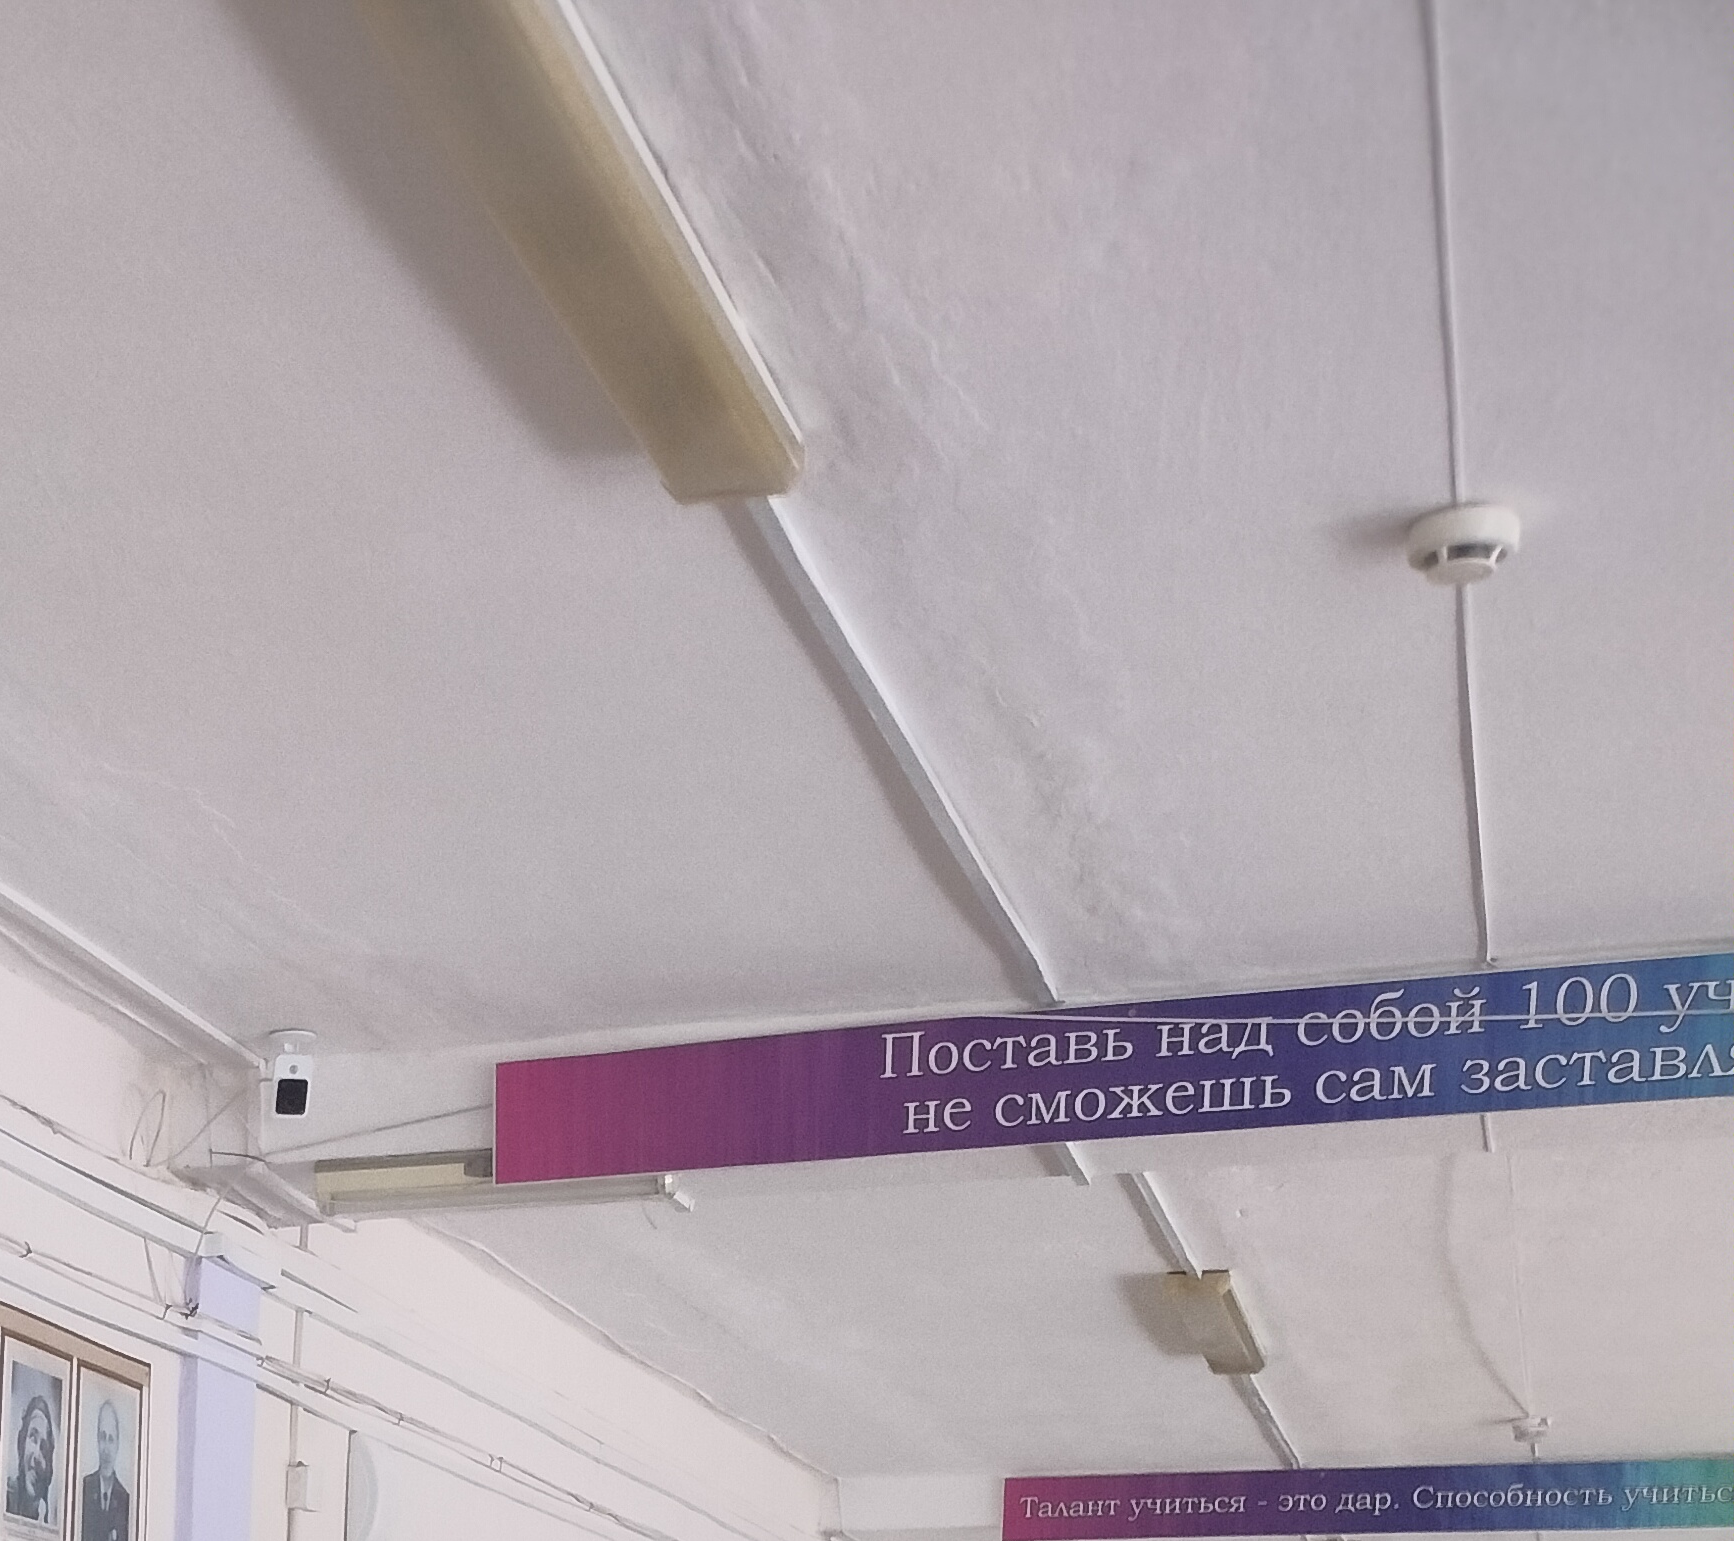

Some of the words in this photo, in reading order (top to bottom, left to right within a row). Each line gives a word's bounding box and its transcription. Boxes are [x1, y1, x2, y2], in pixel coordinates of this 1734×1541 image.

[879, 1027, 1134, 1079] Поставь
[1155, 1016, 1275, 1060] над
[1296, 985, 1488, 1047] собой
[1519, 972, 1639, 1030] 100
[902, 1095, 973, 1135] не
[994, 1073, 1292, 1128] сможешь
[1315, 1062, 1437, 1104] сам
[1460, 1041, 1734, 1095] заставл
[1019, 1496, 1121, 1520] Талант
[1127, 1495, 1247, 1522] учиться
[1276, 1492, 1327, 1514] это
[1334, 1490, 1400, 1521] дар.
[1412, 1483, 1614, 1510] Способность
